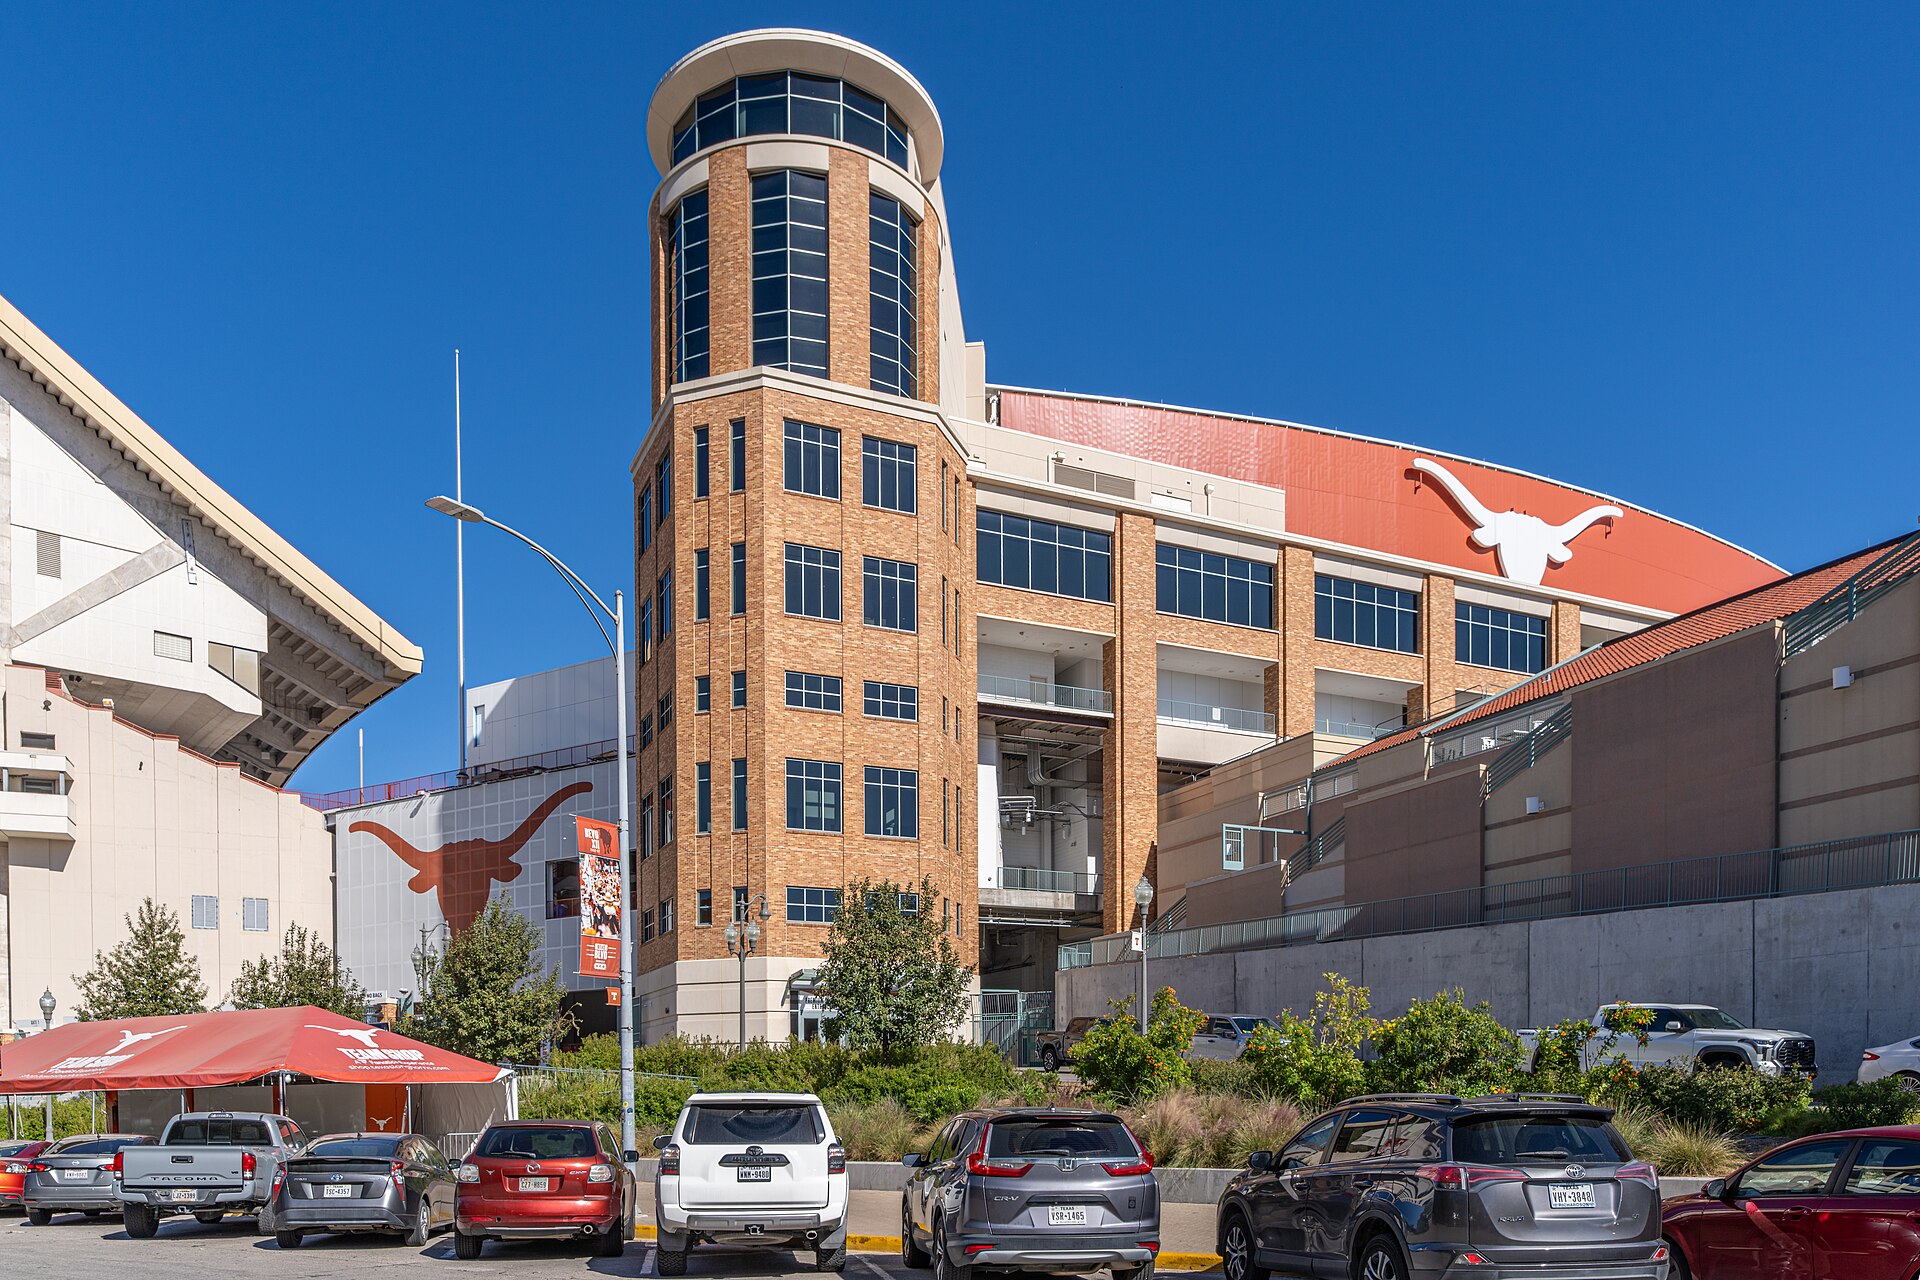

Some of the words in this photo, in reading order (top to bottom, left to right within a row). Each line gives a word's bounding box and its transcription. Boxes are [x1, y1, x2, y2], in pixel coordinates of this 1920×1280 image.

[611, 991, 618, 1000] T
[336, 1047, 390, 1060] TEAM
[380, 1048, 424, 1060] SHOP
